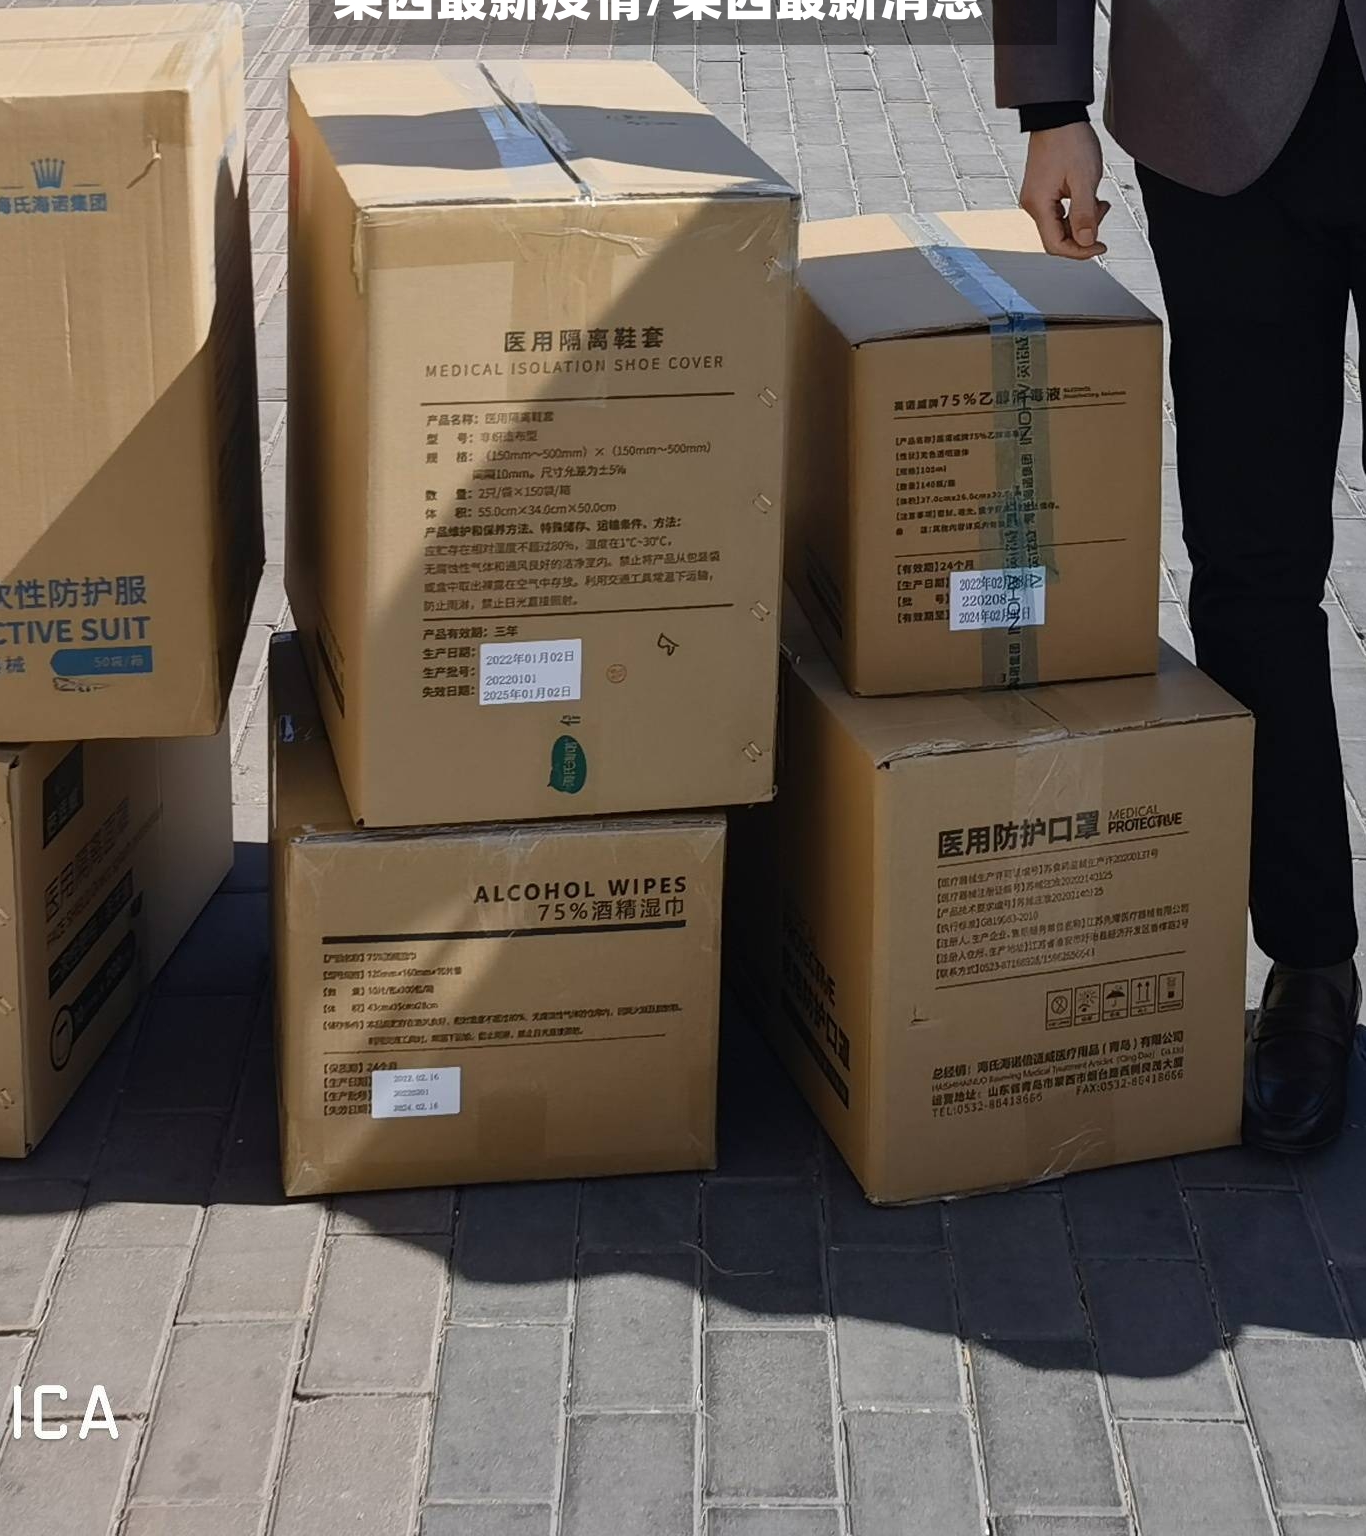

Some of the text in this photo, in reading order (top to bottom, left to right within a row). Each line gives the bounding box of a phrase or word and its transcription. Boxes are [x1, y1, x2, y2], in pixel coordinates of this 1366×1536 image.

[503, 325, 665, 353] 医用隔离鞋套
[425, 355, 724, 378] MEDICAL ISOLATION SHOE COVER
[80, 616, 151, 642] SUIT
[485, 650, 575, 666] 2022年01月02日
[485, 673, 537, 687] 20220101
[483, 686, 572, 702] 2025年01月02日
[1107, 804, 1161, 821] MEDICAL
[937, 810, 1100, 860] 医用防护口罩
[473, 876, 688, 904] ALCOHOL WIPES
[536, 899, 685, 922] 75%酒精湿巾
